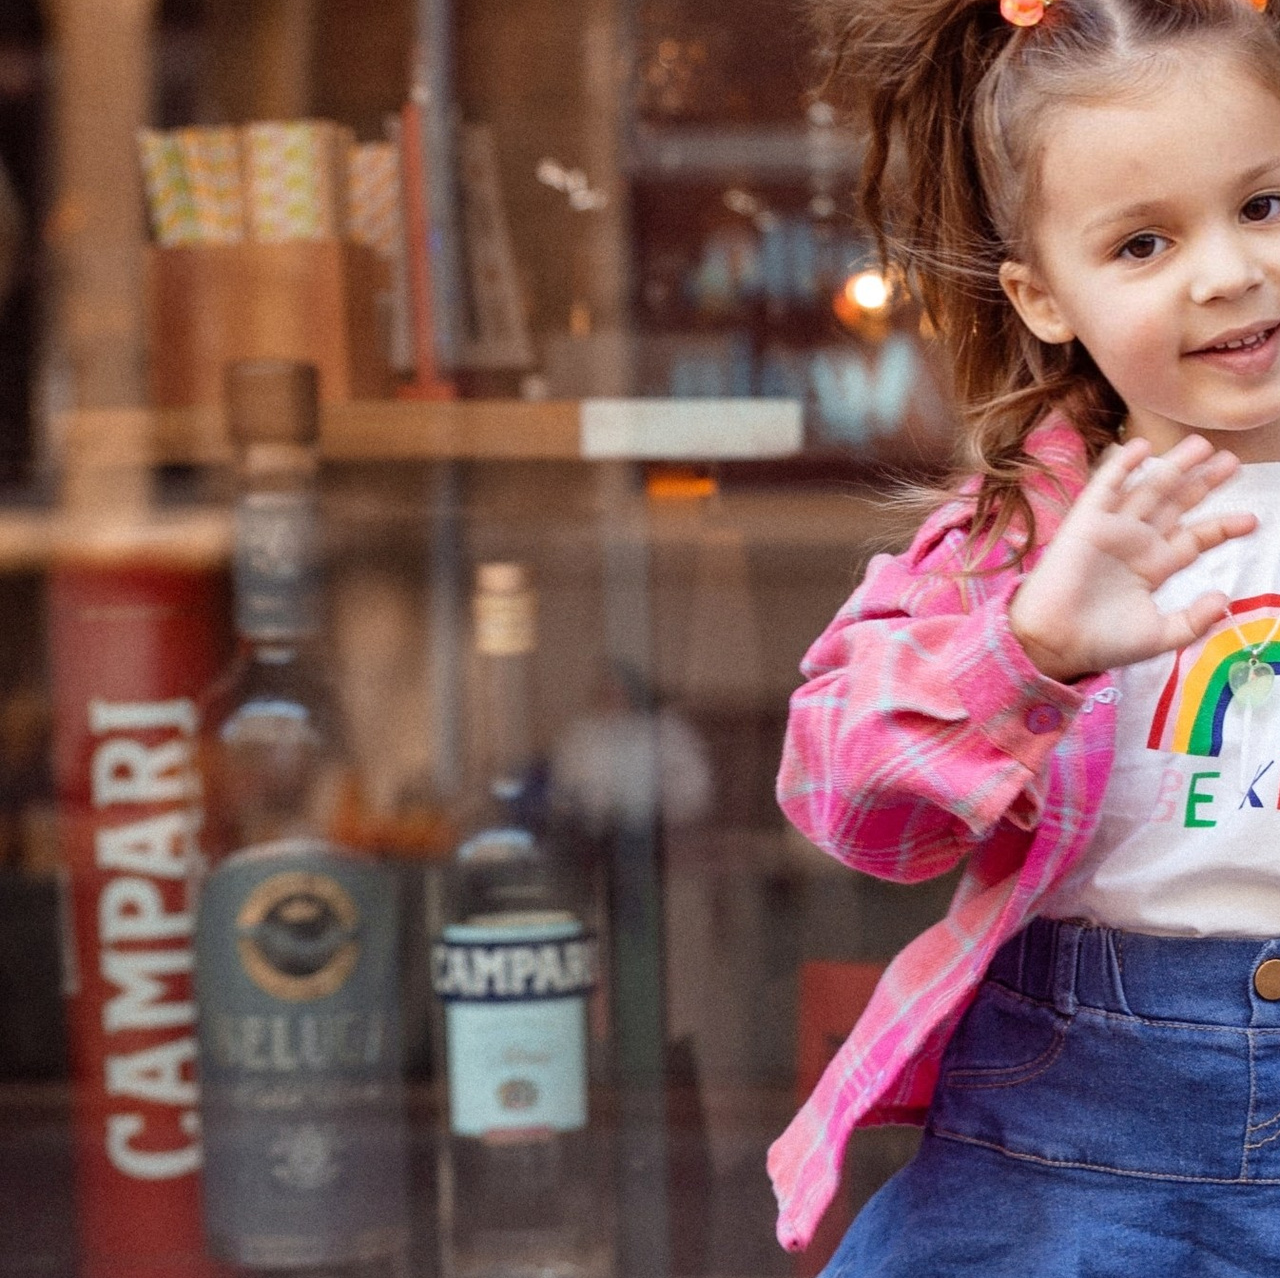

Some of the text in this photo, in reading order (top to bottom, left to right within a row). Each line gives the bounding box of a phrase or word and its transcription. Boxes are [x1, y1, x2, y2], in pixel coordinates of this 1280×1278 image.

[1151, 769, 1221, 828] BE
[89, 697, 204, 1180] CAMPARI
[432, 938, 594, 997] CAMPAR
